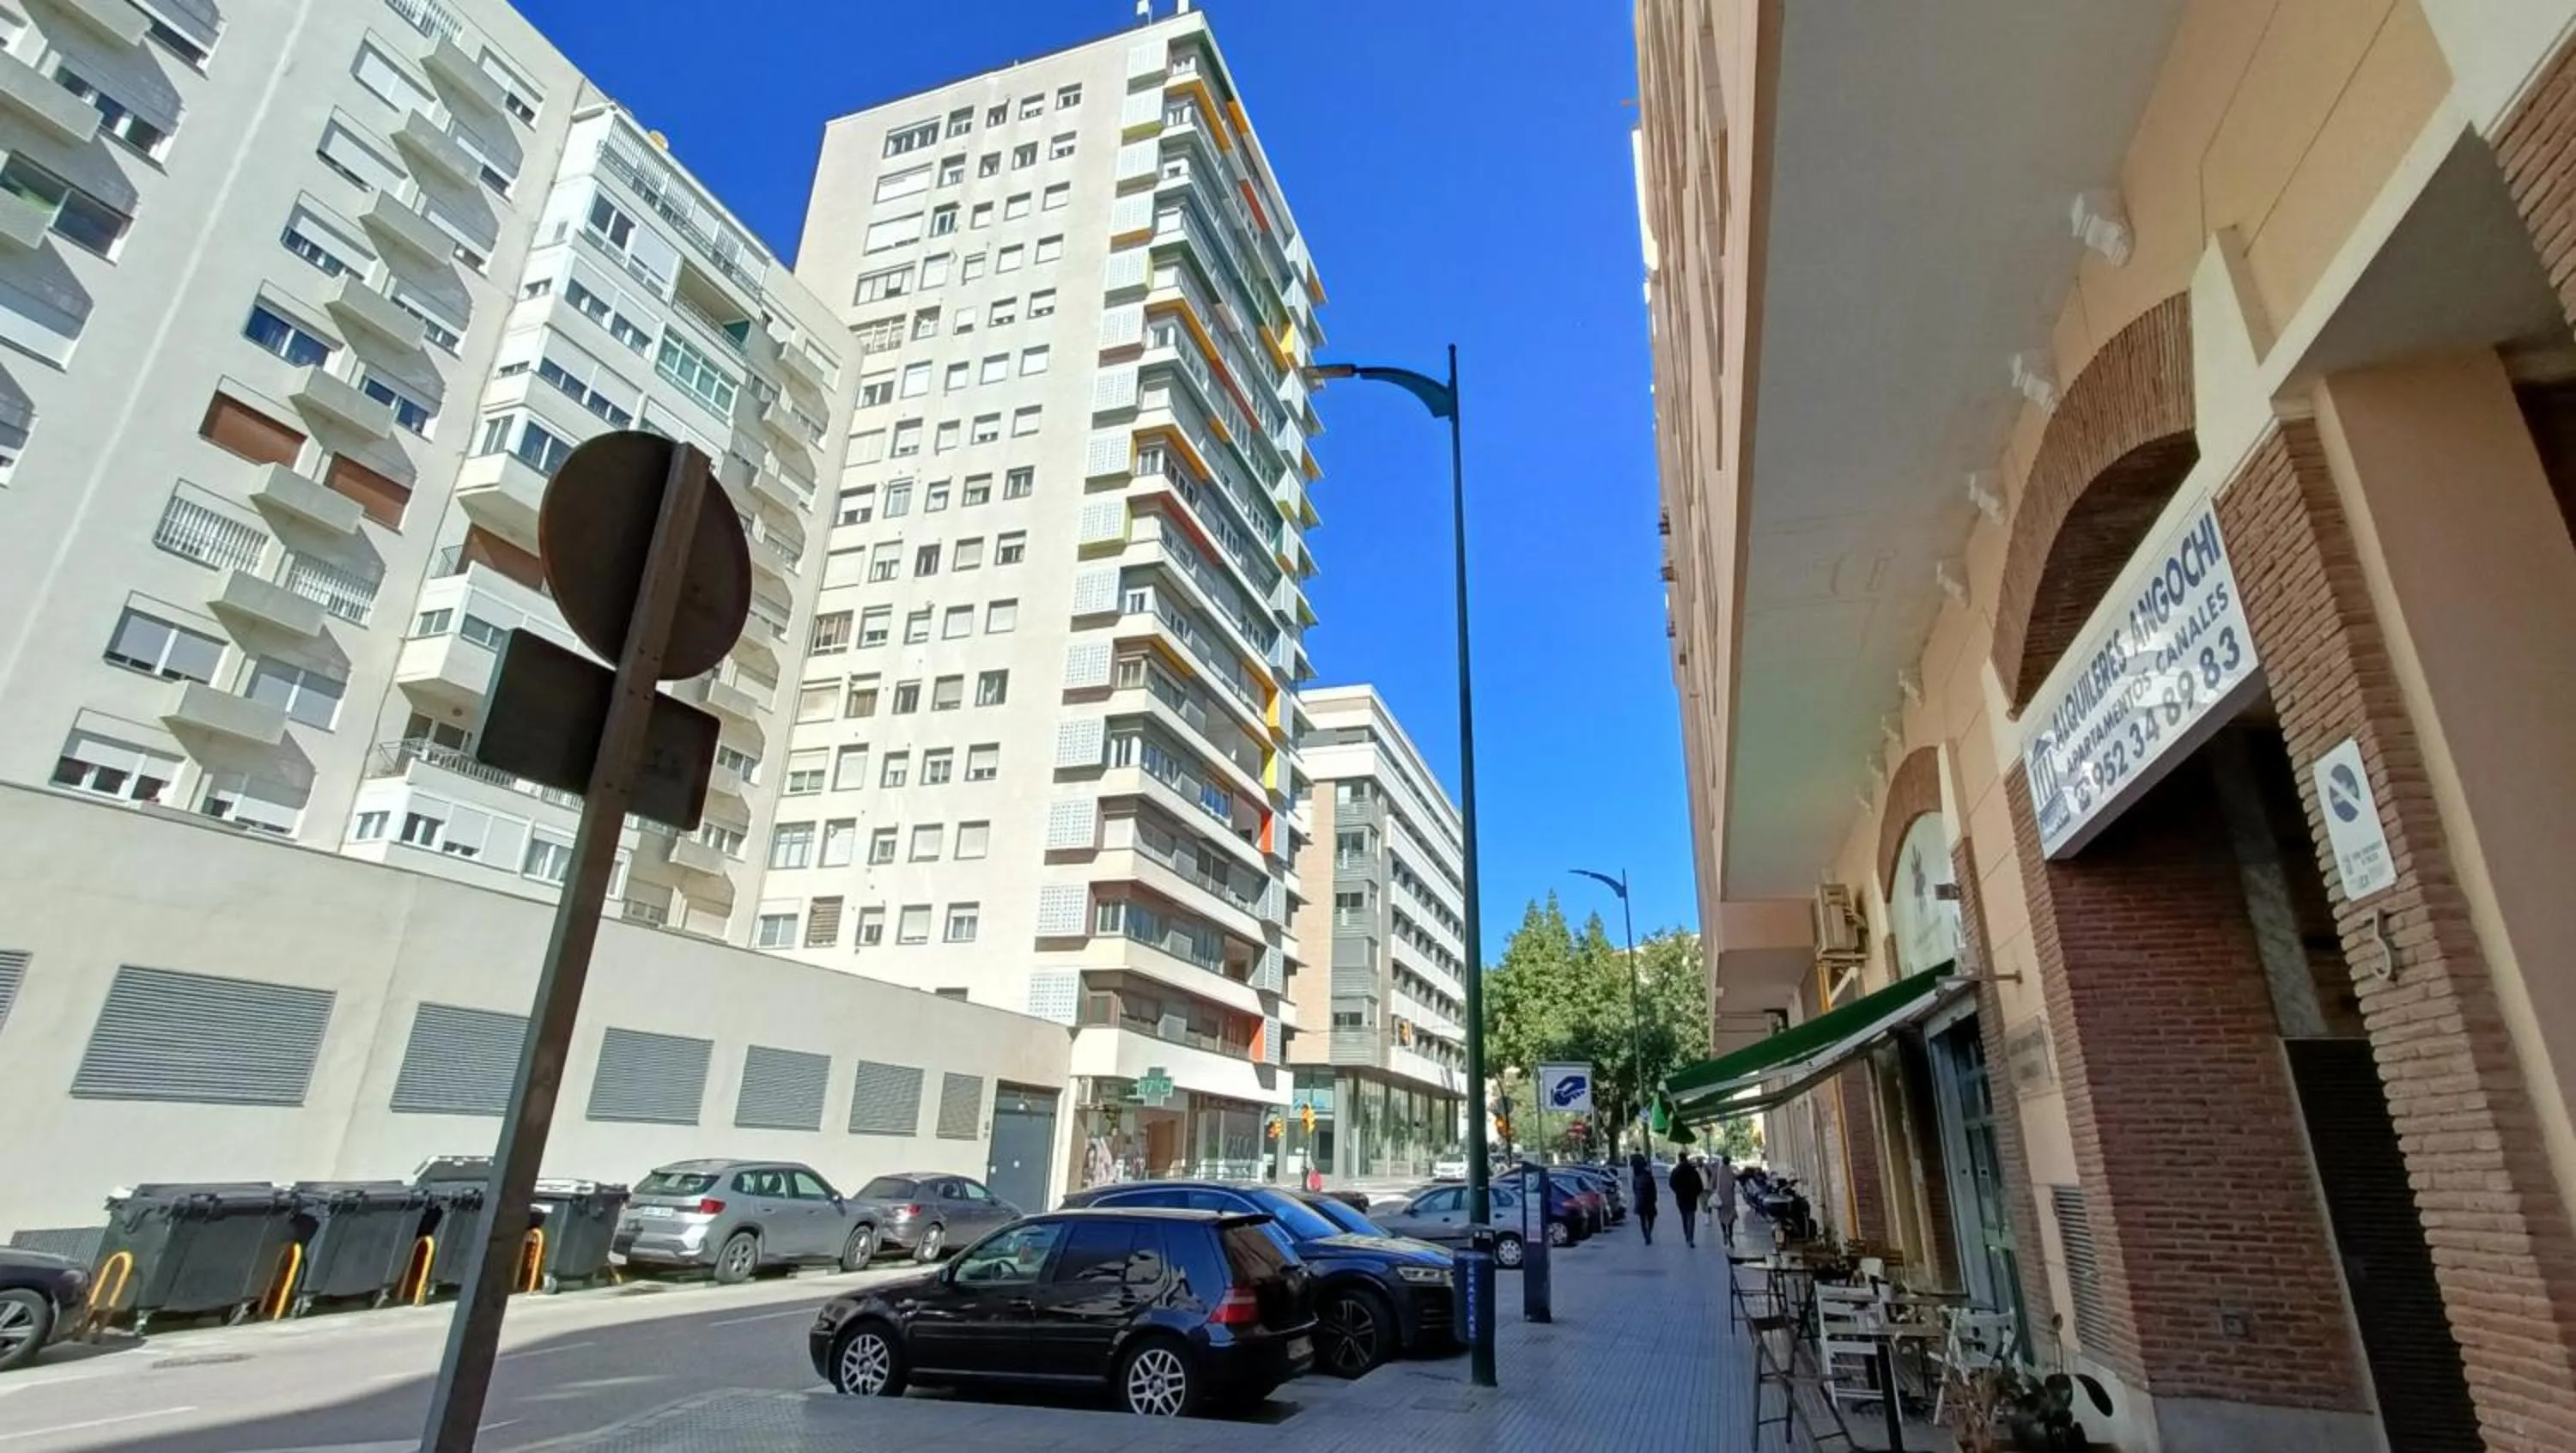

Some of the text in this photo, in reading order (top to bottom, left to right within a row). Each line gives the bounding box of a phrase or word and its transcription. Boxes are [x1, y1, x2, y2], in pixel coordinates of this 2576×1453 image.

[2052, 511, 2221, 751] ALQUILERES ANGOCHI
[2067, 581, 2228, 776] APARTAMENTOS CANALES
[2092, 626, 2240, 794] 952 34 89 83
